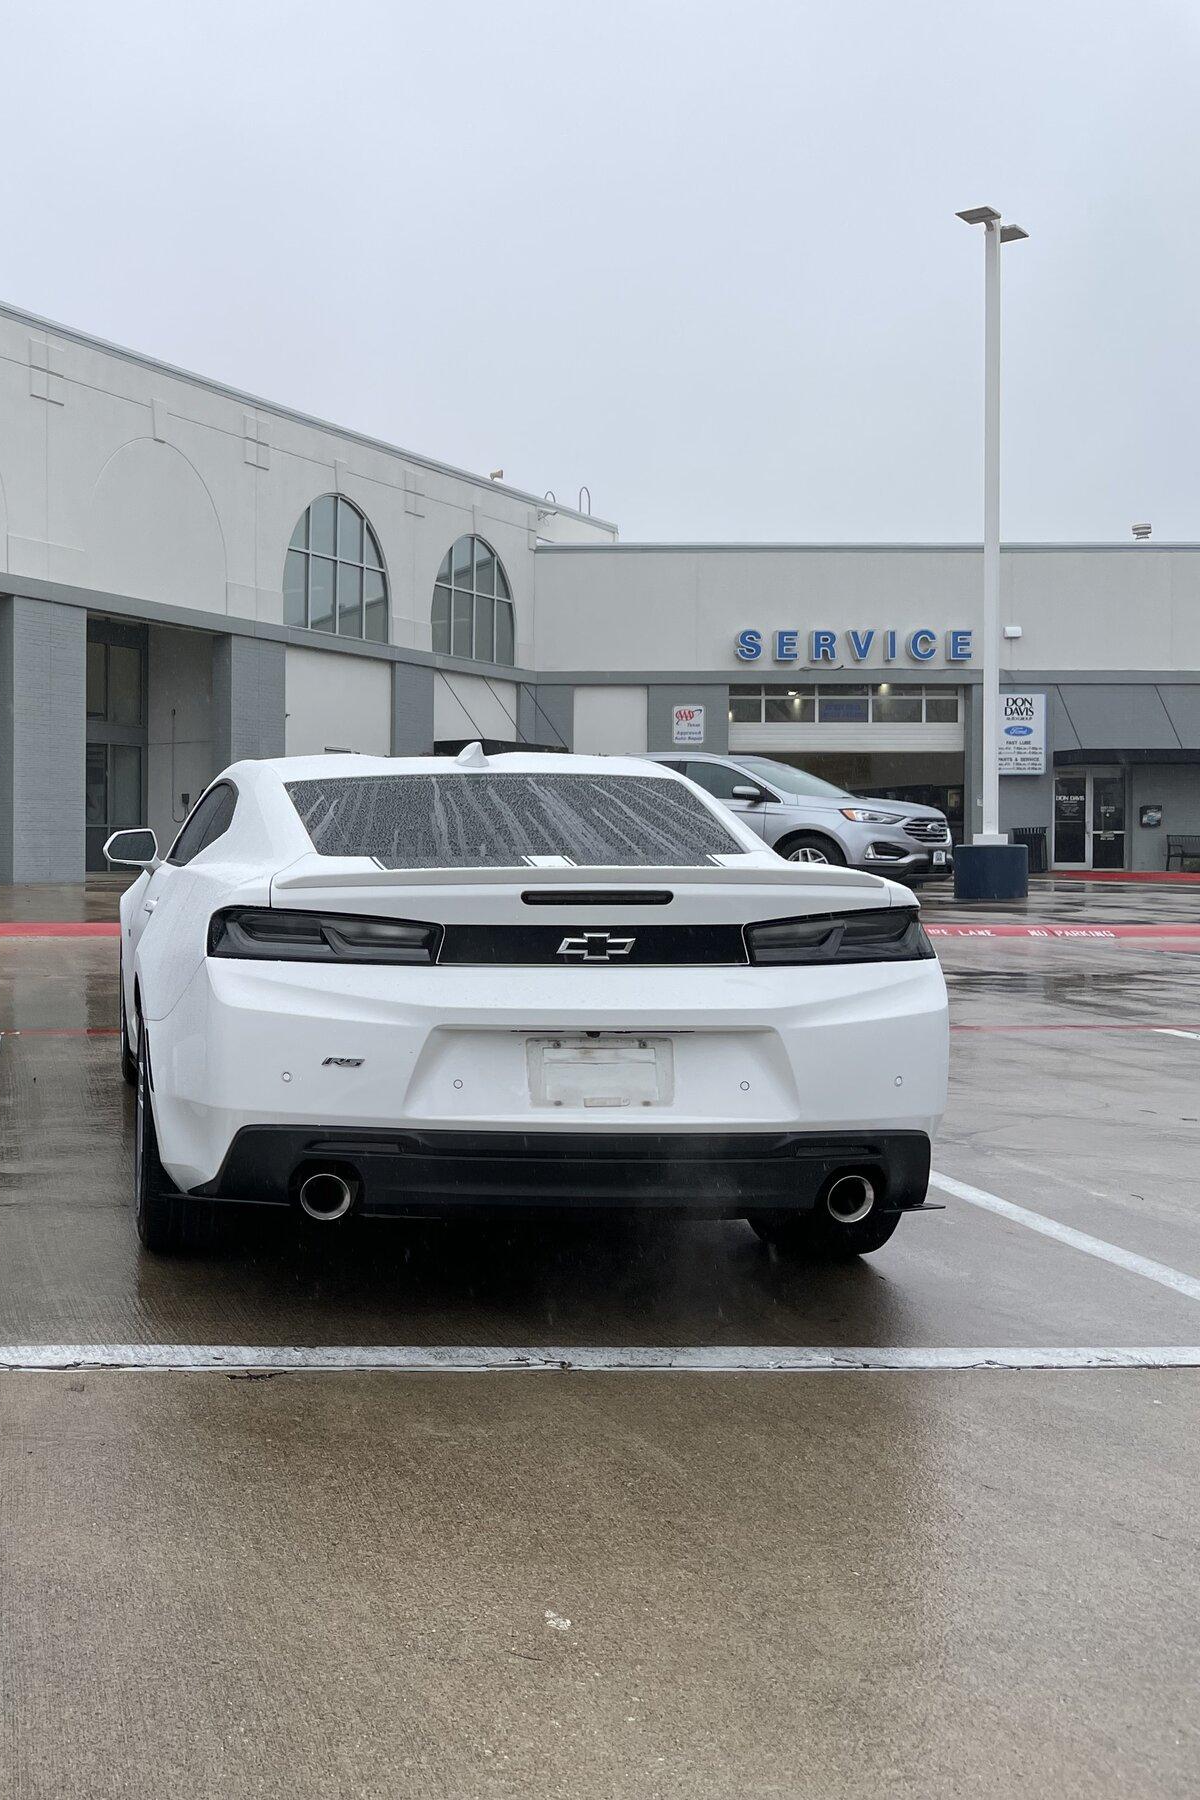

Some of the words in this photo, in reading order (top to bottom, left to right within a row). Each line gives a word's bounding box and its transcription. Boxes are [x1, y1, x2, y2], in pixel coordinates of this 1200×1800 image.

[736, 629, 973, 662] SERVICE
[1006, 697, 1033, 707] DON
[1004, 706, 1034, 717] DAVIS
[925, 928, 951, 936] IRE
[958, 929, 997, 937] LANE
[1027, 929, 1049, 937] NO
[1054, 929, 1116, 938] PARKING
